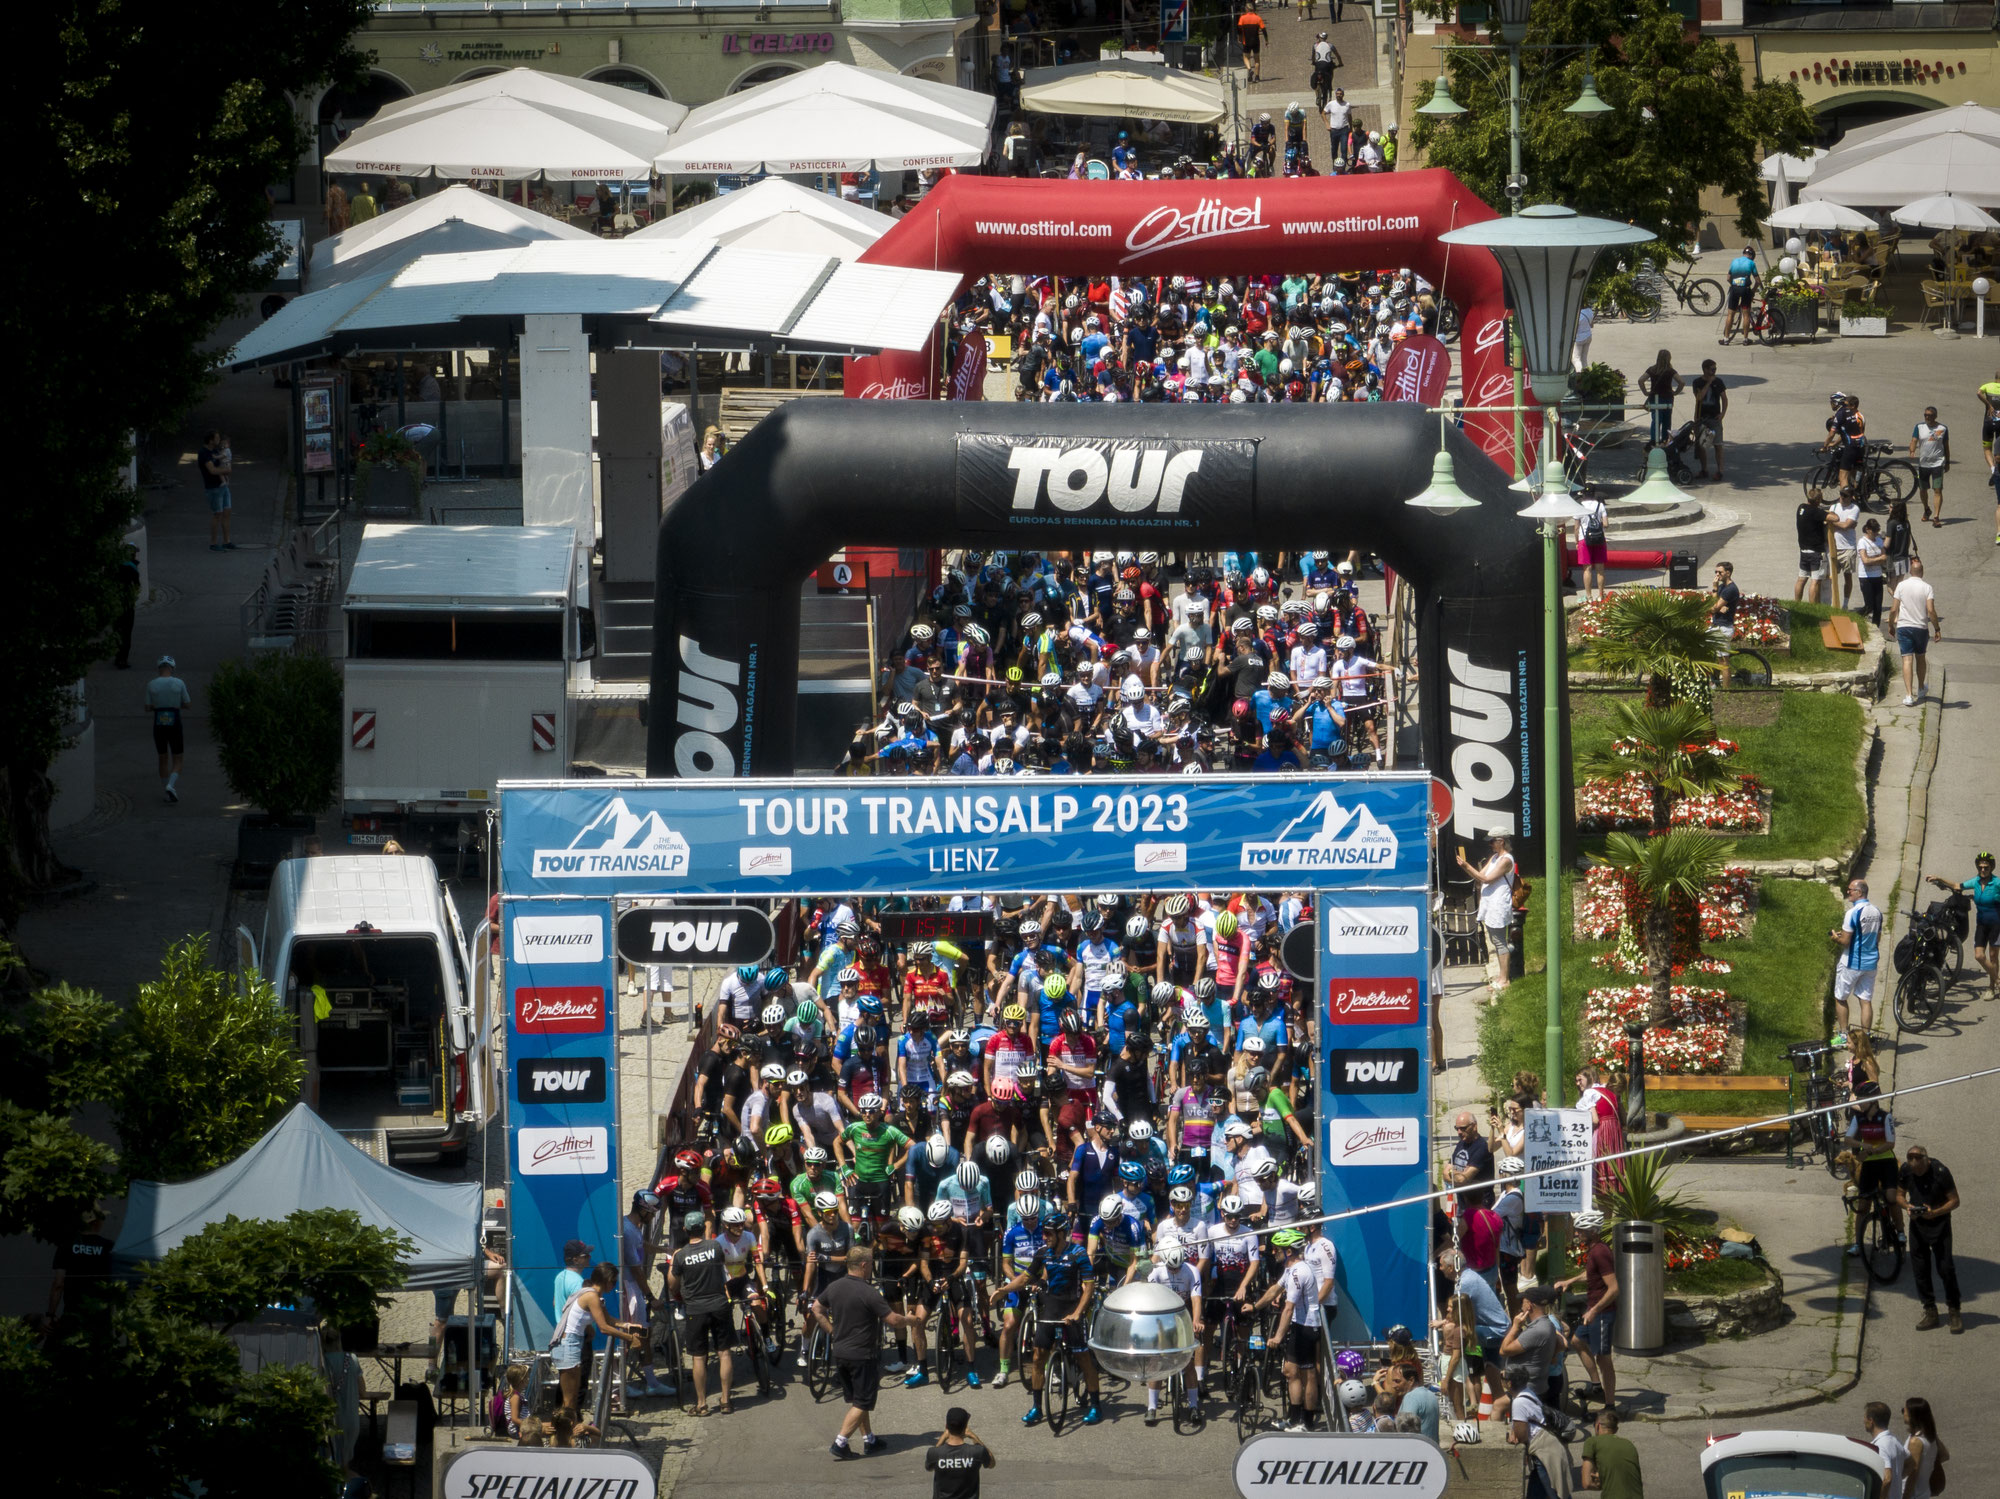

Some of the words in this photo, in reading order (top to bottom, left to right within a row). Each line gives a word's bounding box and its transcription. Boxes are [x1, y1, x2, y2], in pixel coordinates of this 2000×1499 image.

[722, 34, 742, 53] IL
[749, 32, 835, 53] GELATO
[447, 49, 546, 61] TRACHTENWELT
[1854, 60, 1884, 69] SCHUHE
[1886, 60, 1901, 69] VON
[1838, 68, 1919, 84] RIEDER
[1124, 106, 1150, 117] Gelato
[1152, 111, 1192, 120] artigianale
[355, 162, 401, 172] CITY-CAFE
[684, 162, 733, 171] GELATERIA
[789, 161, 847, 171] PASTICCERIA
[902, 156, 954, 167] CONFISERIE
[471, 168, 506, 177] GLANZL
[571, 169, 624, 178] KONDITOREI
[975, 220, 1112, 238] www.osttirol.com
[1120, 196, 1267, 255] Osttirol
[1282, 214, 1420, 235] www.osttirol.com
[955, 343, 975, 400] sttirol
[1395, 347, 1421, 402] sttirol
[1009, 516, 1062, 526] EUROPAS
[1064, 516, 1118, 526] RENNRAD
[1120, 518, 1171, 528] MAGAZIN
[1174, 518, 1193, 528] NR.
[838, 566, 848, 582] A
[748, 650, 758, 669] NR.
[1518, 657, 1526, 676] NR.
[746, 671, 756, 722] MAGAZIN
[1518, 678, 1529, 731] MAGAZIN
[674, 634, 741, 779] OUR
[742, 724, 753, 778] RENNRAD
[1520, 732, 1530, 785] RENNRAD
[739, 798, 849, 836] TOUR
[861, 796, 1079, 835] TRANSALP
[1092, 794, 1189, 832] 2023
[1522, 786, 1532, 838] EUROPAS
[589, 854, 684, 872] TRANSALP
[929, 847, 1000, 873] LIENZ
[1297, 848, 1392, 864] TRANSALP
[901, 917, 982, 936] 11:53:11
[1338, 924, 1408, 937] SPECIALIZED
[523, 934, 593, 946] SPECIALIZED
[1344, 1126, 1405, 1152] Osttirol
[1561, 1140, 1588, 1148] 25.06
[533, 1136, 594, 1162] Osttirol
[1539, 1176, 1579, 1190] Lienz
[72, 1244, 104, 1256] CREW
[684, 1248, 716, 1266] CREW
[938, 1457, 974, 1469] CREW
[1250, 1460, 1429, 1486] SPECIALIZED
[461, 1474, 640, 1499] SPECIALIZED
